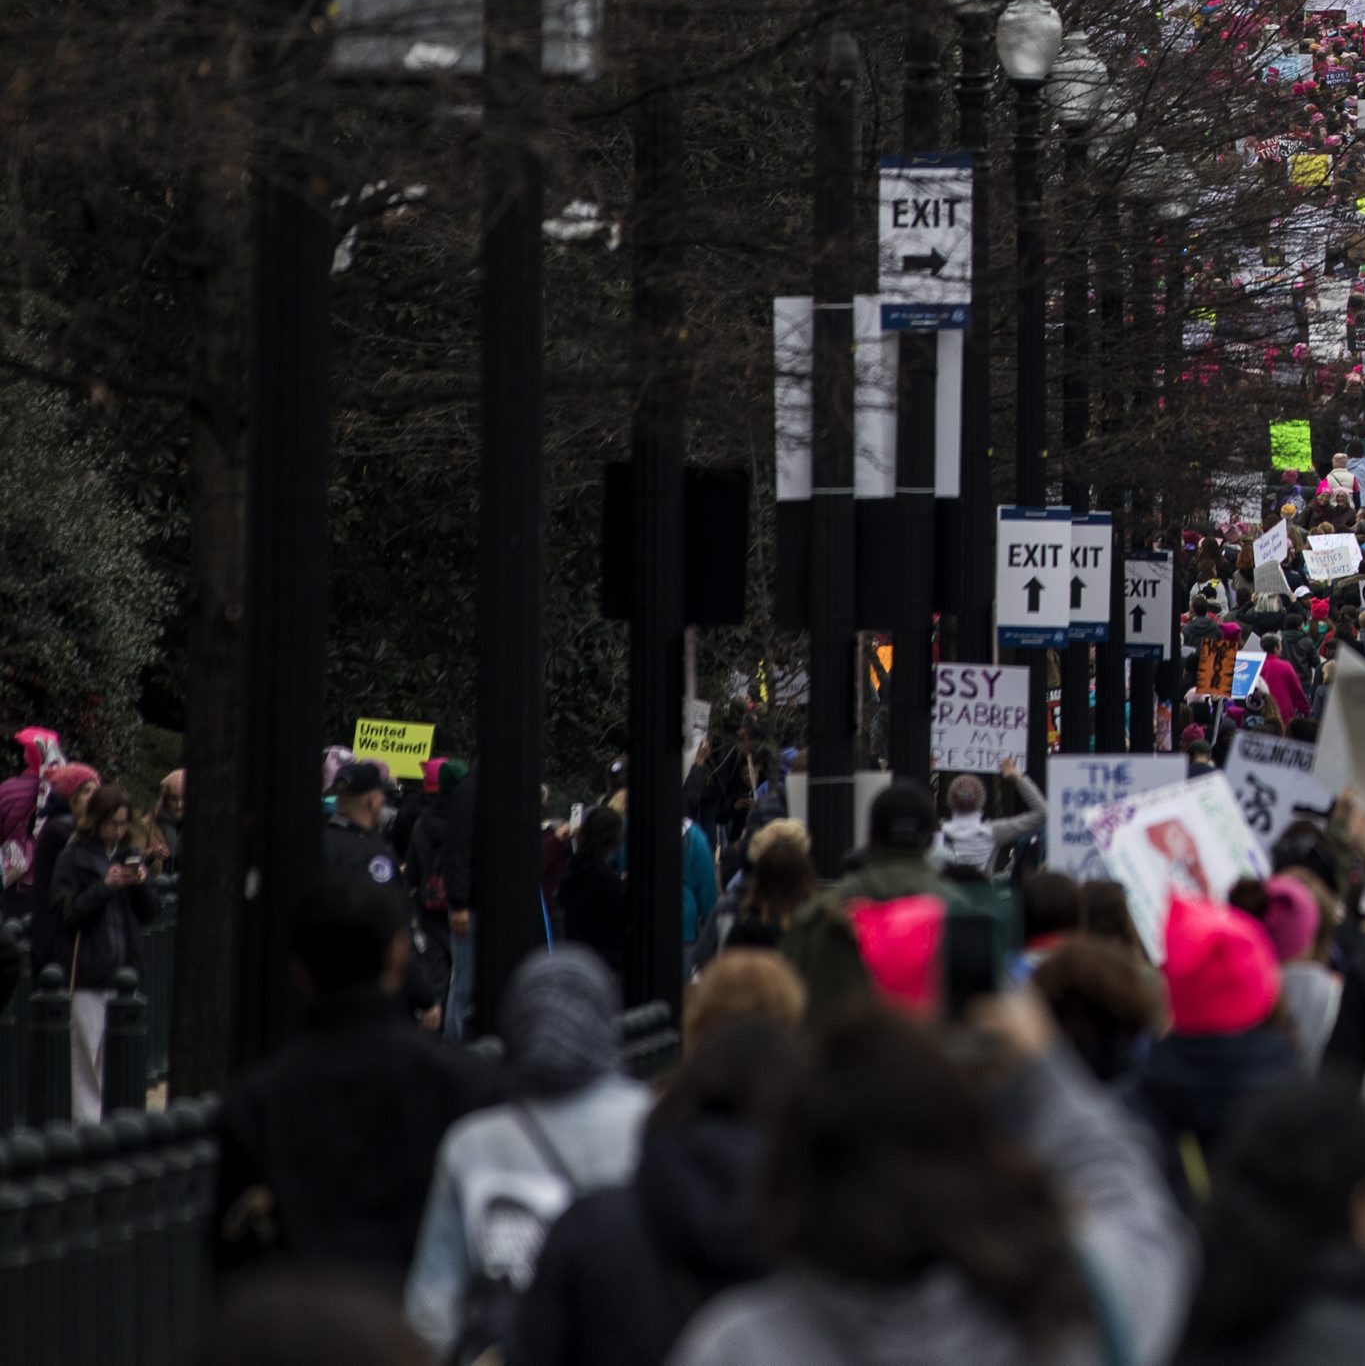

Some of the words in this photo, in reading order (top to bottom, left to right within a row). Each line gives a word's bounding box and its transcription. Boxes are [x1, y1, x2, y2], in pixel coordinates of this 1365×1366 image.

[1325, 72, 1349, 80] TRUST
[892, 198, 963, 229] EXIT
[1007, 544, 1063, 569] EXIT
[1071, 545, 1105, 569] XIT
[1310, 552, 1343, 563] POLITICS
[360, 724, 406, 739] United
[359, 737, 379, 750] We
[380, 739, 426, 755] Stand!
[1088, 762, 1131, 785] THE
